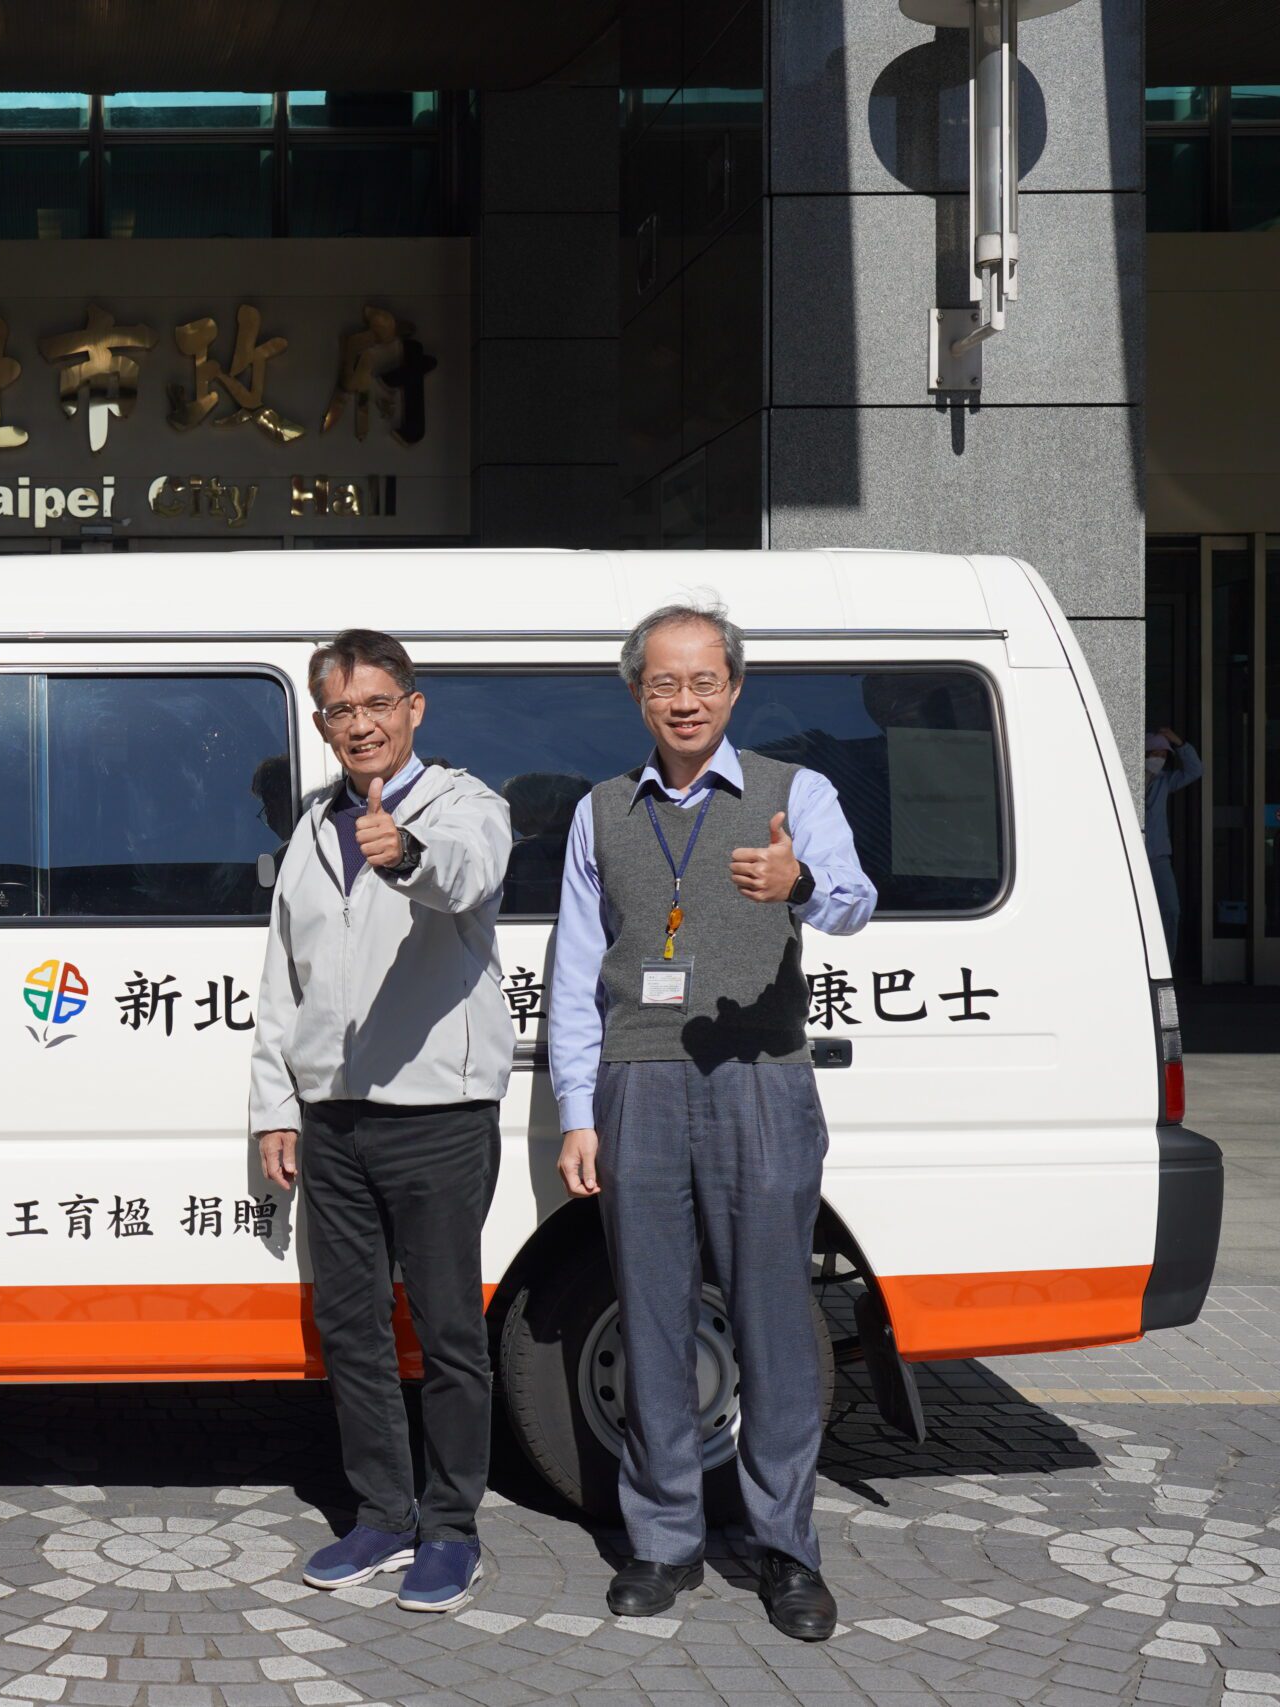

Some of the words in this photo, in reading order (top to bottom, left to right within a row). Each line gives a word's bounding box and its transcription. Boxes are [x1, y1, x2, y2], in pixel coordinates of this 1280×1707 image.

[147, 474, 258, 527] City
[290, 475, 397, 517] Hall
[114, 969, 256, 1037] 新北
[805, 962, 1000, 1031] 康巴士
[5, 1193, 154, 1241] 王育楹
[179, 1193, 278, 1240] 捐贈
